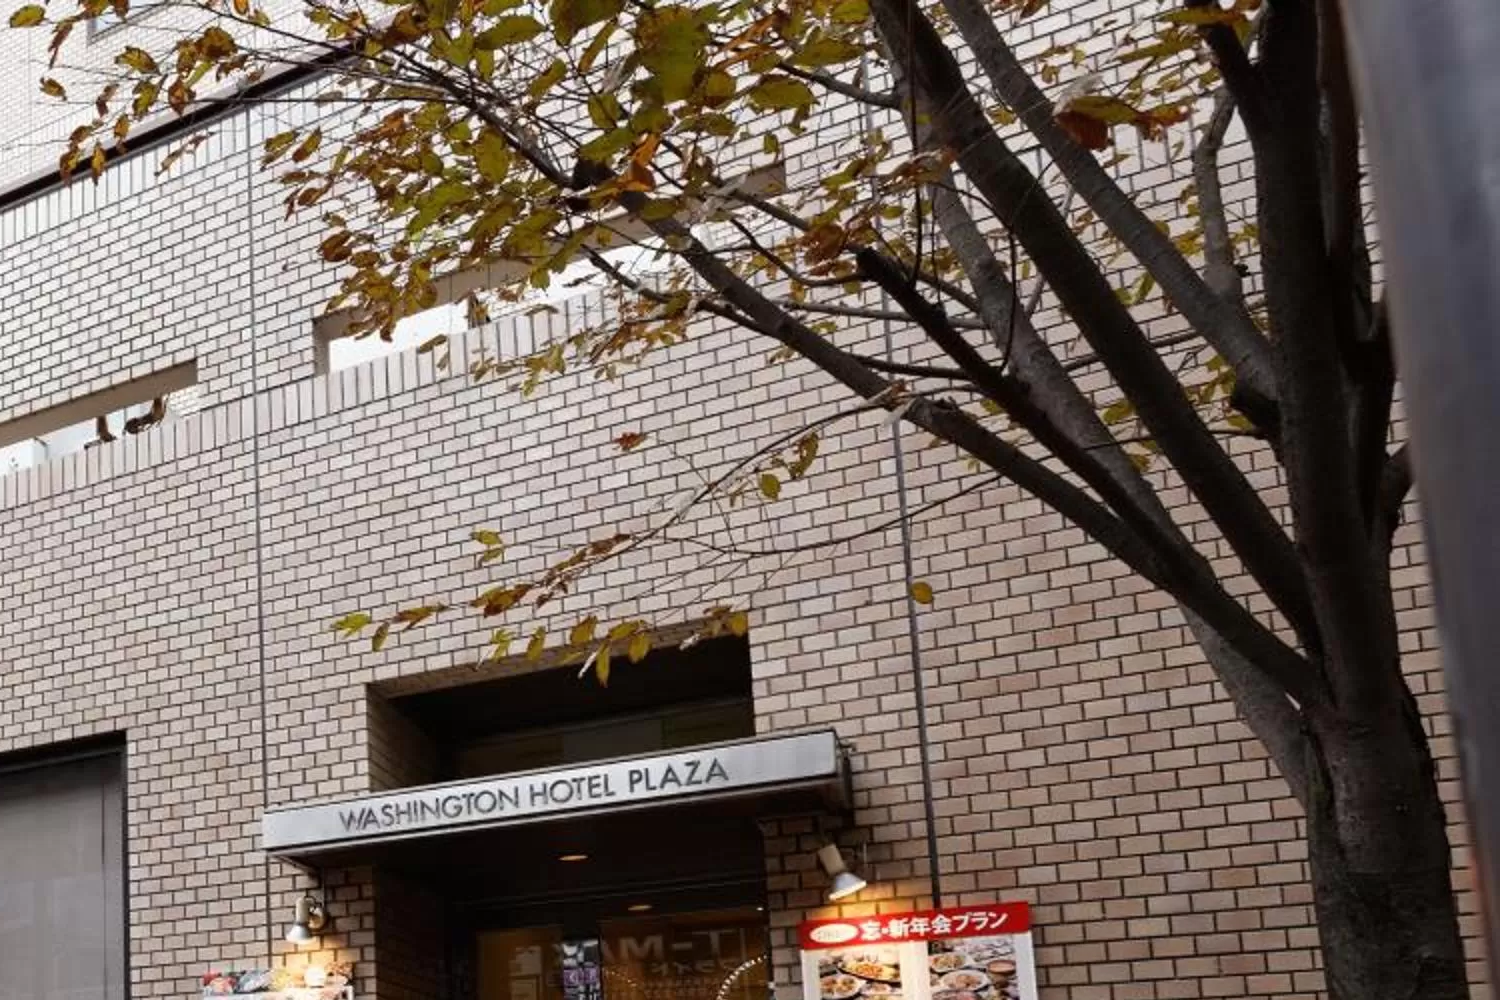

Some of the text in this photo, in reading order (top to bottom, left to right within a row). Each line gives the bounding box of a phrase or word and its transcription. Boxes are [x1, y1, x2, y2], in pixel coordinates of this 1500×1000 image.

[339, 758, 730, 832] WASHINGTON HOTEL PLAZA
